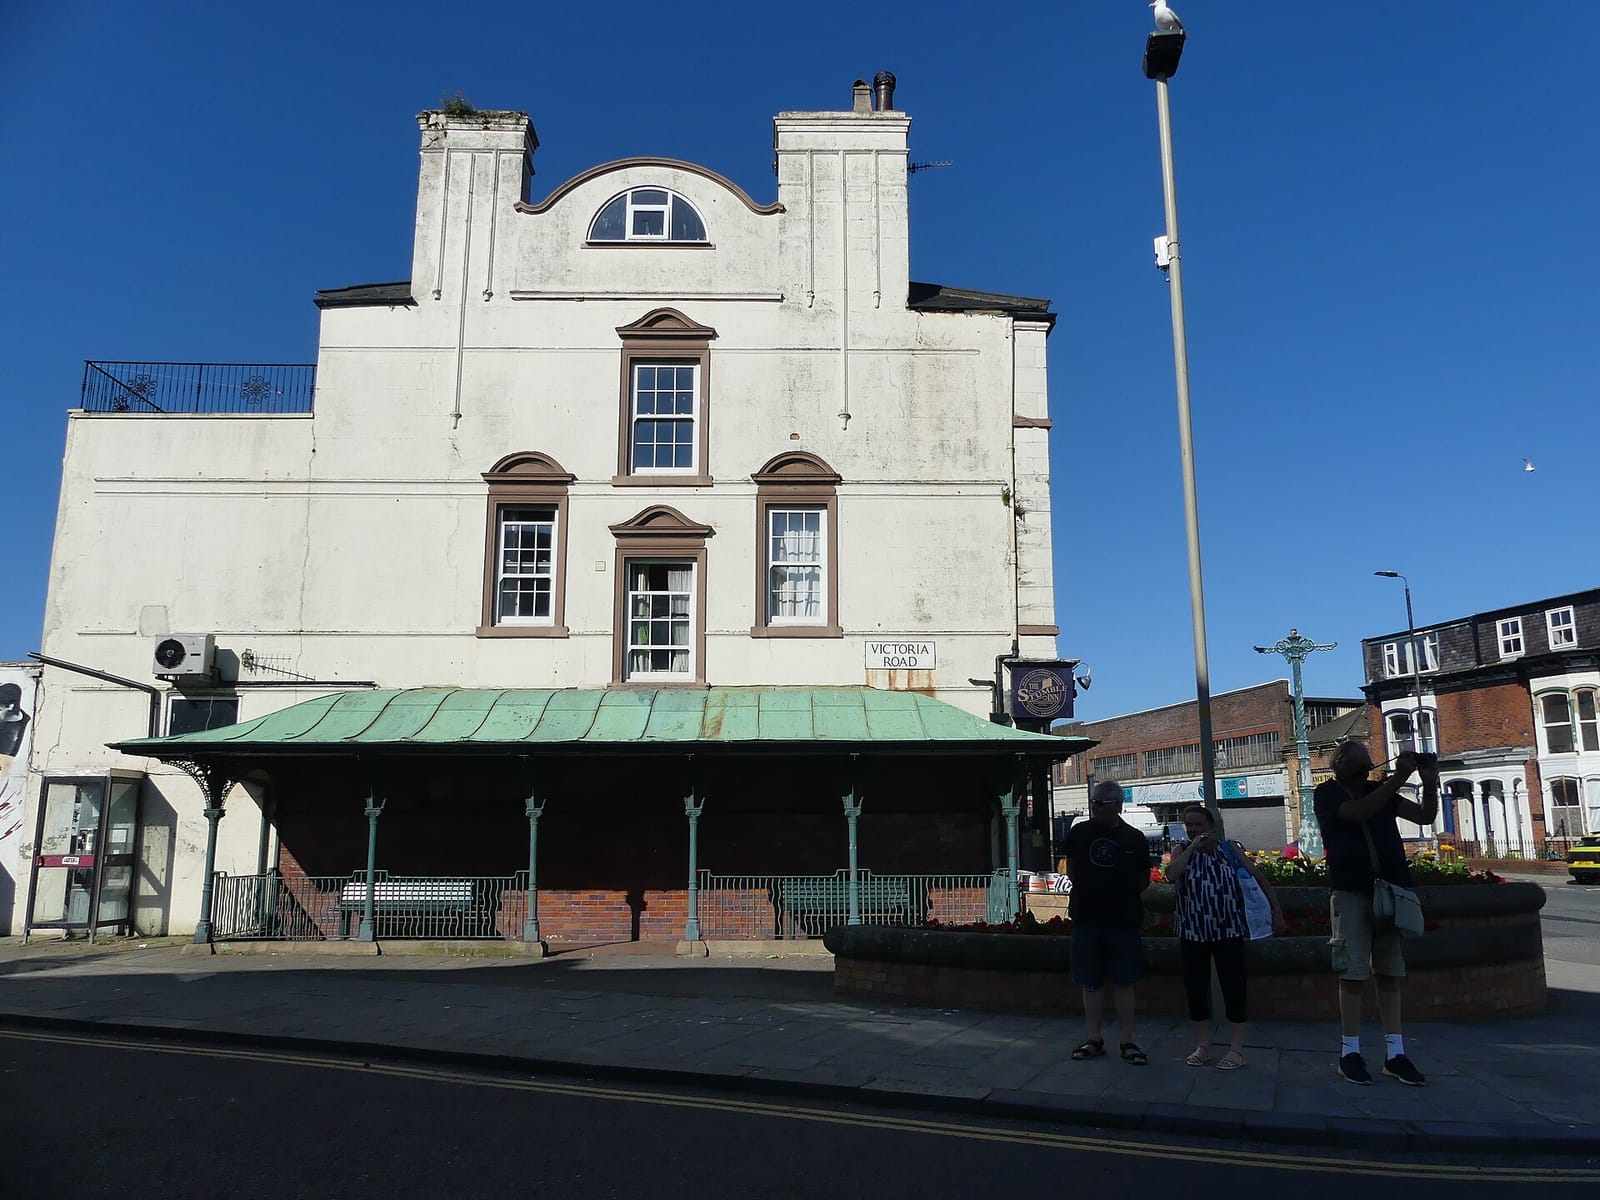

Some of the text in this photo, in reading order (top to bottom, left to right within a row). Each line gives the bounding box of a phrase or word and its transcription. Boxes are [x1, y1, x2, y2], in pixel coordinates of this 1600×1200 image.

[871, 643, 929, 655] VICTORIA
[883, 656, 918, 667] ROAD
[1223, 780, 1238, 788] DRIVE
[1225, 788, 1236, 796] OUT
